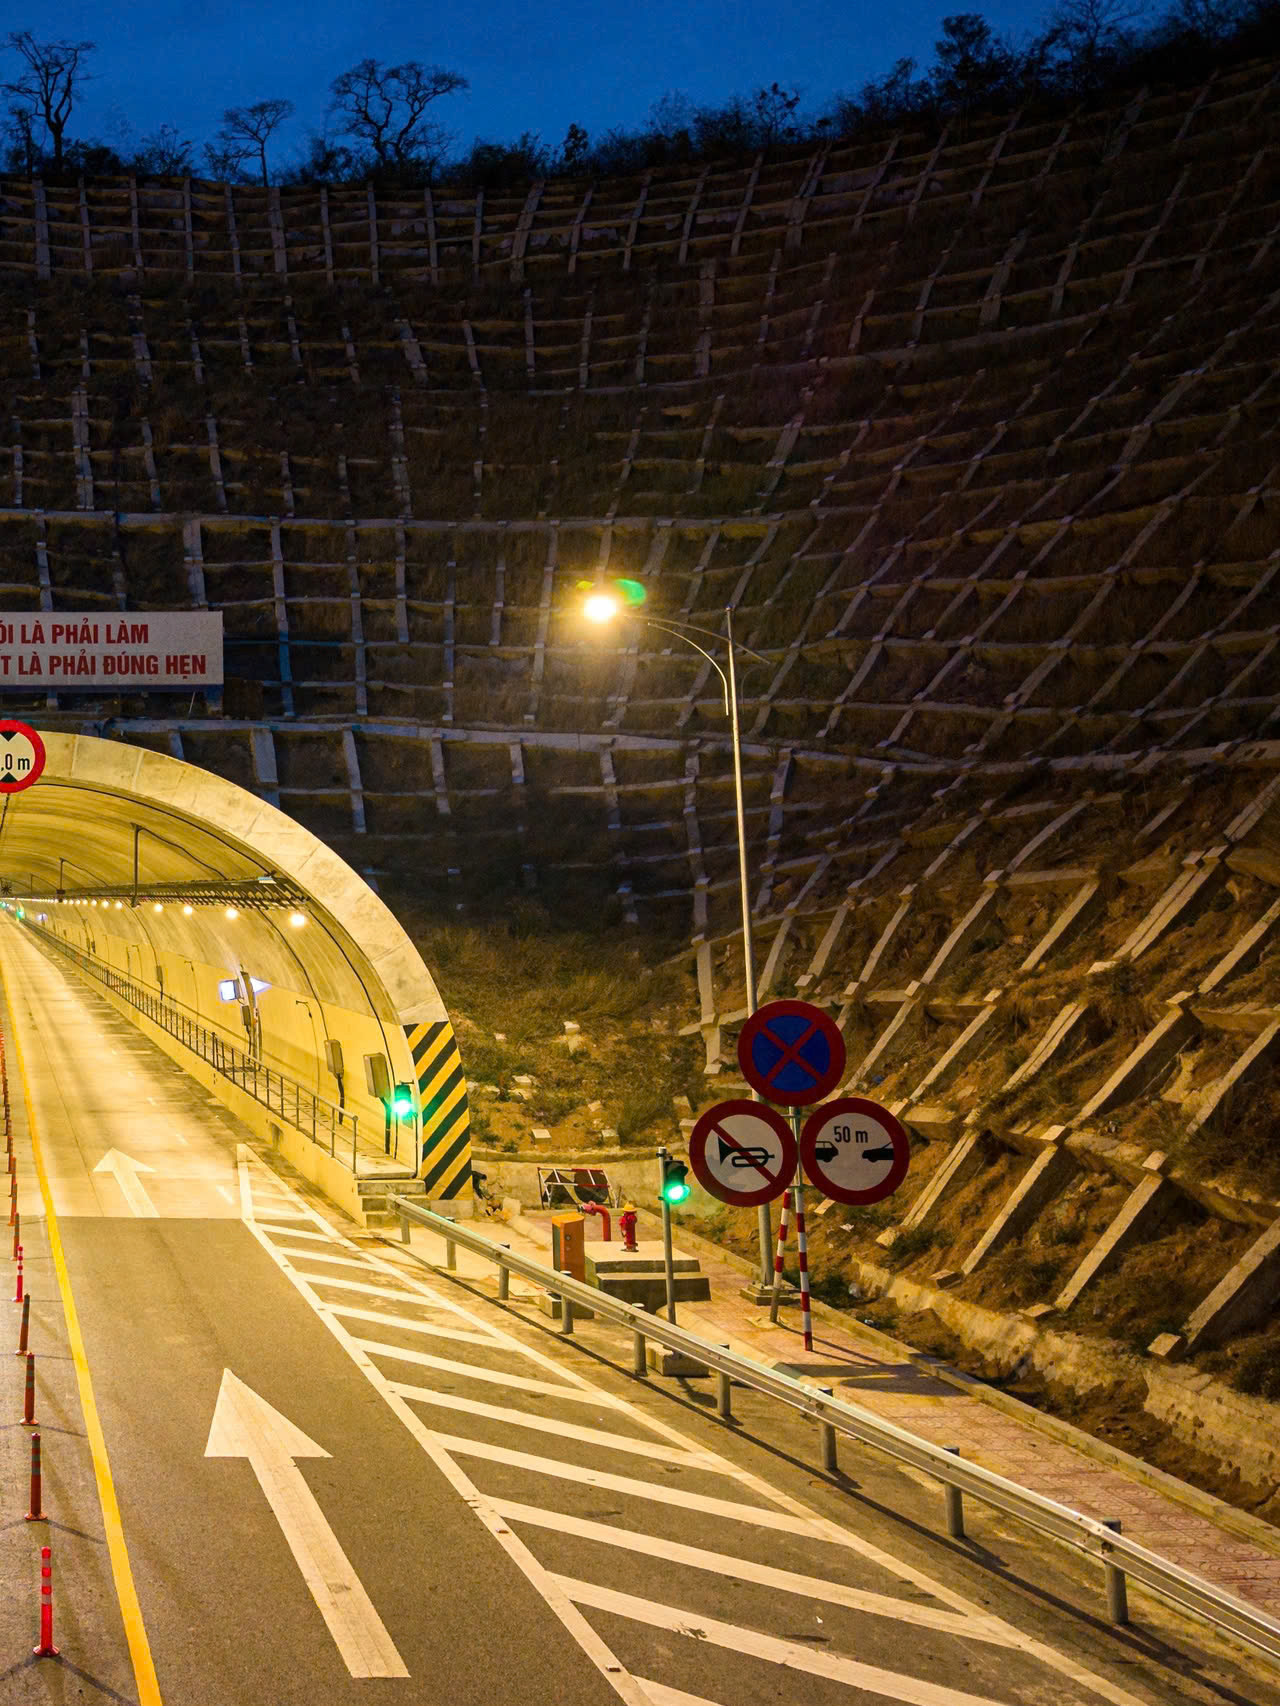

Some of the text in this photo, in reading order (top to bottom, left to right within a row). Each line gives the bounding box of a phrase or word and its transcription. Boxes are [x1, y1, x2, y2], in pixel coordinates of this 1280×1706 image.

[21, 619, 45, 644] LÀ
[51, 617, 99, 644] PHẢI
[105, 619, 149, 644] LÀM
[18, 651, 42, 675] LÀ
[49, 648, 96, 675] PHẢI
[102, 651, 159, 675] ĐÚNG
[165, 654, 206, 679] HẸN
[17, 758, 30, 770] m
[834, 1126, 868, 1143] 50 m
